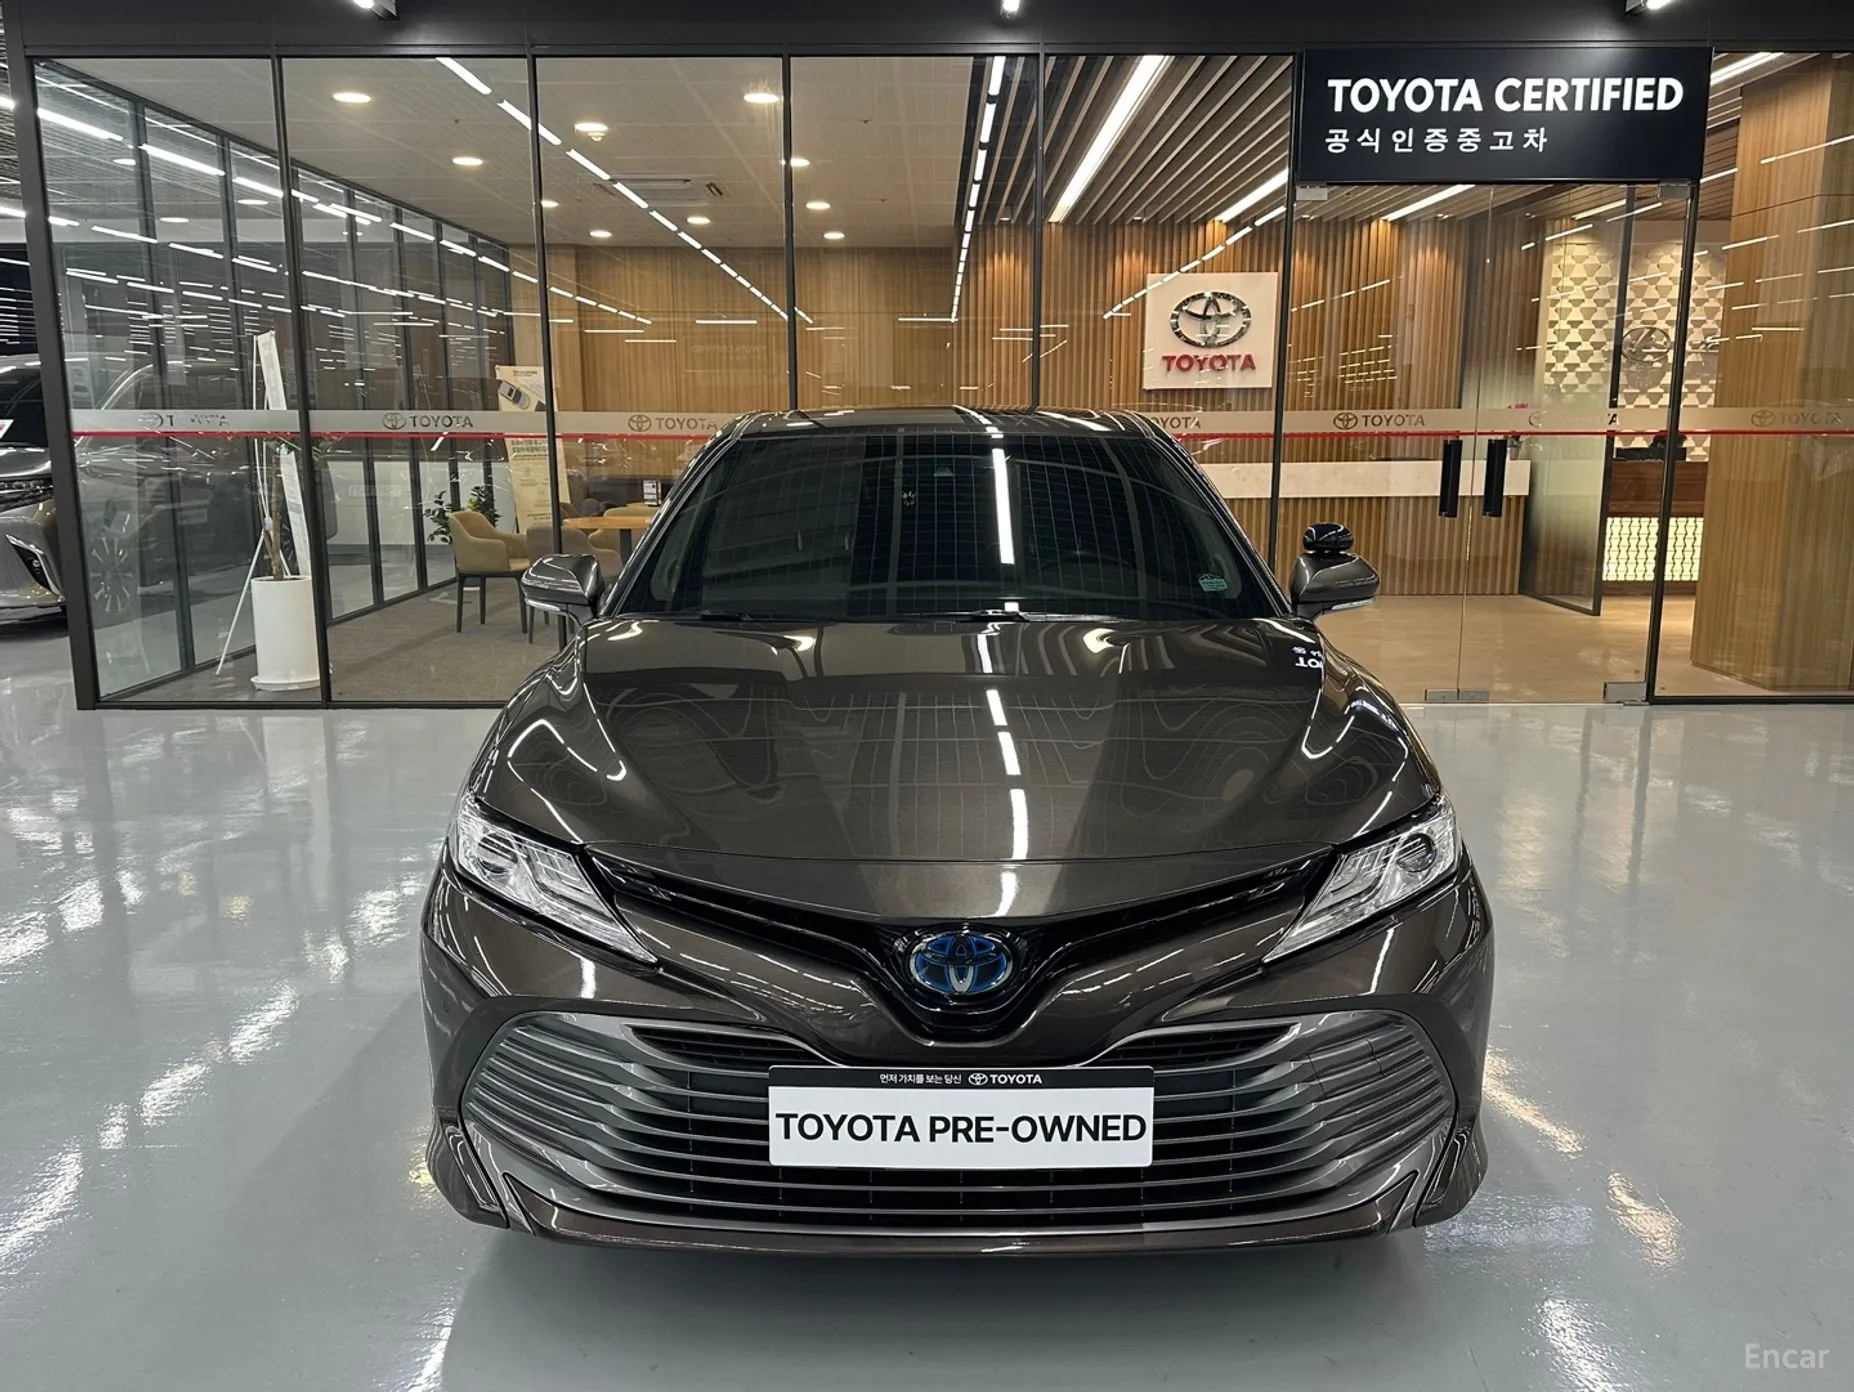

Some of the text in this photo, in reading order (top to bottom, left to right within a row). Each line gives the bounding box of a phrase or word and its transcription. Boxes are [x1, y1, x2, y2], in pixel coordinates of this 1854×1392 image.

[1327, 77, 1685, 113] TOYOTA CERTIFIED
[1325, 127, 1548, 154] 공식인증중고차
[1161, 354, 1257, 372] TOYOTA
[409, 415, 474, 428] TOYOTA
[655, 417, 718, 430] TOYOTA
[1150, 416, 1202, 429] YOTA
[1362, 414, 1426, 427] TOYOTA
[879, 1073, 962, 1084] 먼저 가치를 보는 당신
[989, 1073, 1043, 1085] TOYOTA
[775, 1112, 1147, 1144] TOYOTA PRE-OWNED
